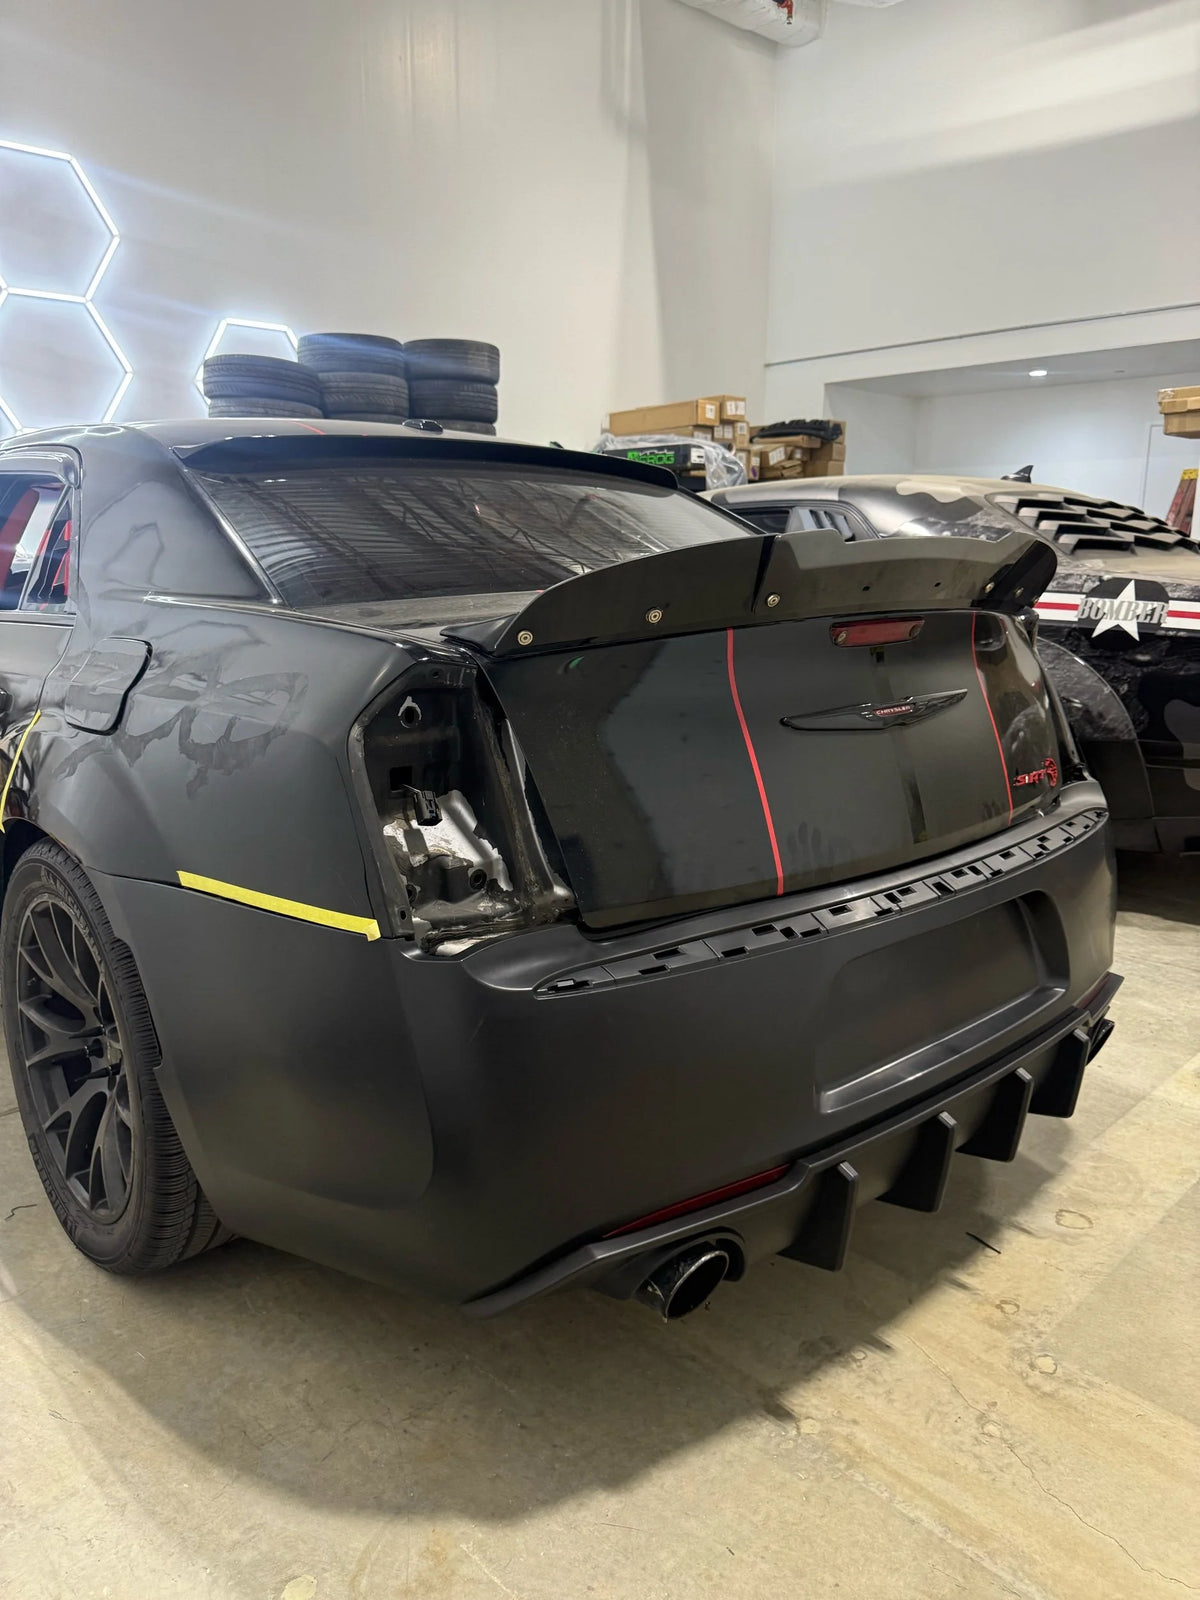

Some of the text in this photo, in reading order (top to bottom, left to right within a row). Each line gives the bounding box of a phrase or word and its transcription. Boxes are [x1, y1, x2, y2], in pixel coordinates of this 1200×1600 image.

[1077, 598, 1169, 625] BOMBER
[876, 705, 911, 715] CHRYSLER
[1013, 769, 1047, 787] SRT
